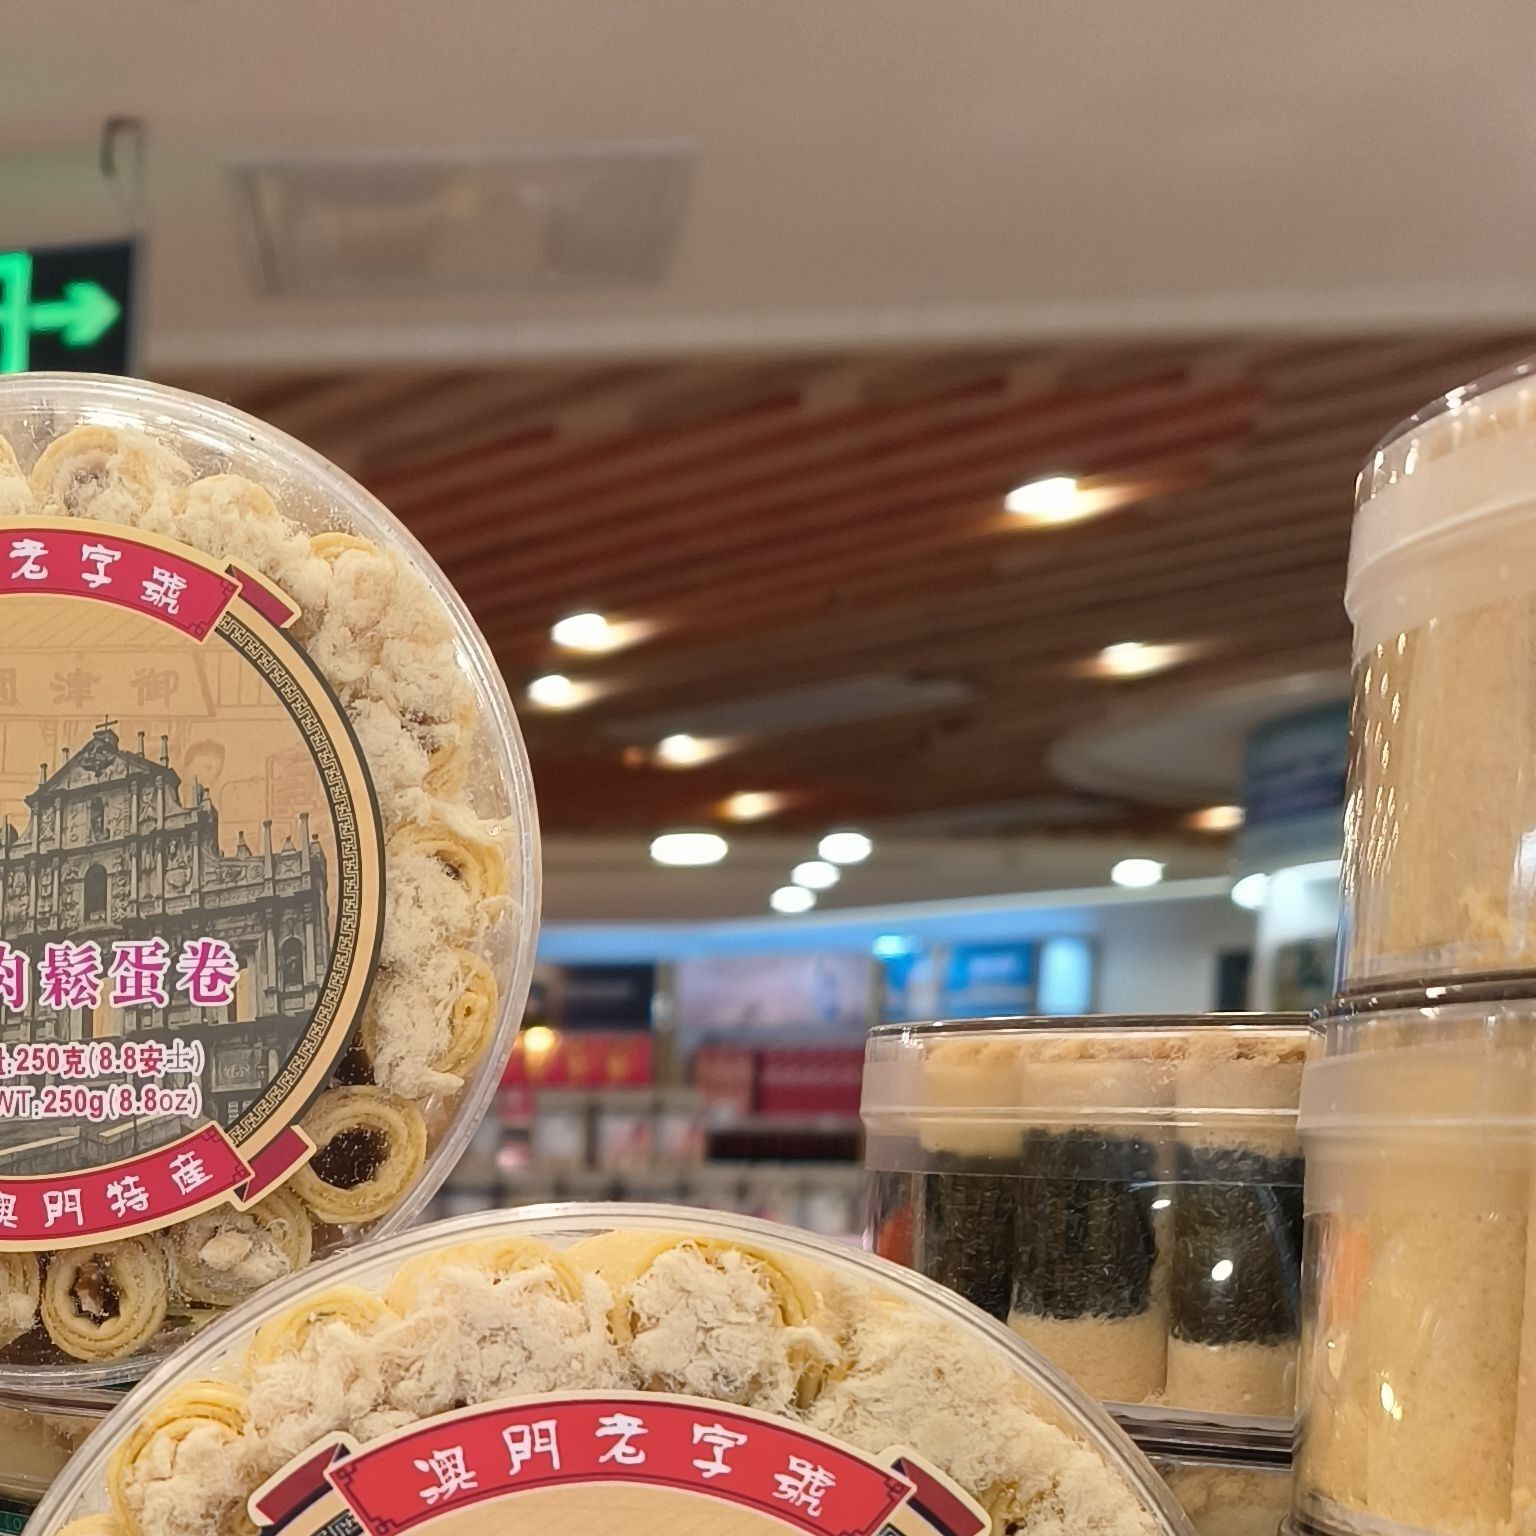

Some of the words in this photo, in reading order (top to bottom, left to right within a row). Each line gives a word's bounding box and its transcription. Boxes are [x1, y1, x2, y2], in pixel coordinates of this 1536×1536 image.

[413, 1411, 839, 1518] 澳門老字號
